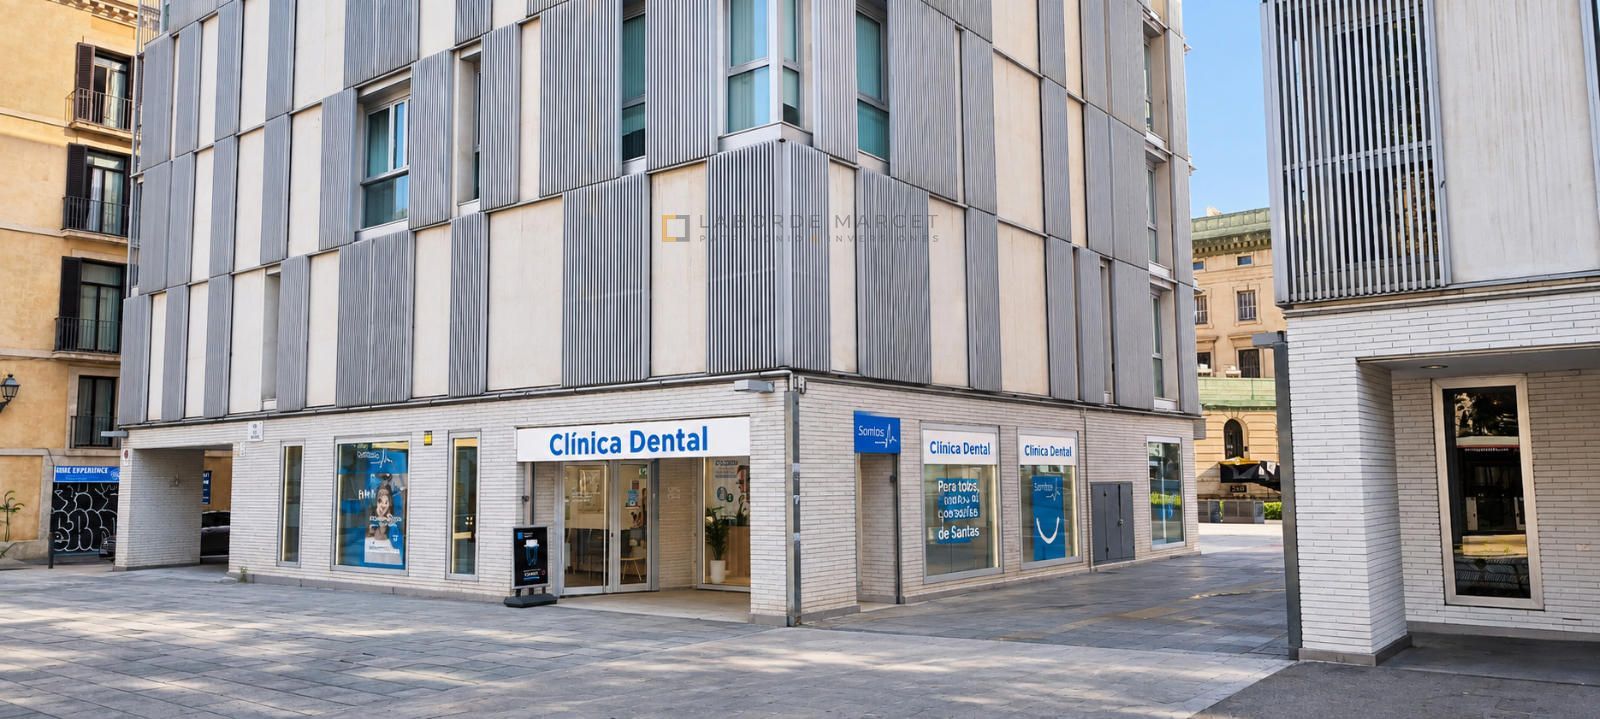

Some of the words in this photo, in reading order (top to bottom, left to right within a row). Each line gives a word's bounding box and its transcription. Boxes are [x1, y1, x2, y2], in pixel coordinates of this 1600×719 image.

[549, 431, 622, 456] Clínica
[629, 425, 709, 453] Dental
[963, 442, 991, 456] Dental
[1050, 445, 1072, 457] Dental
[938, 526, 950, 540] de
